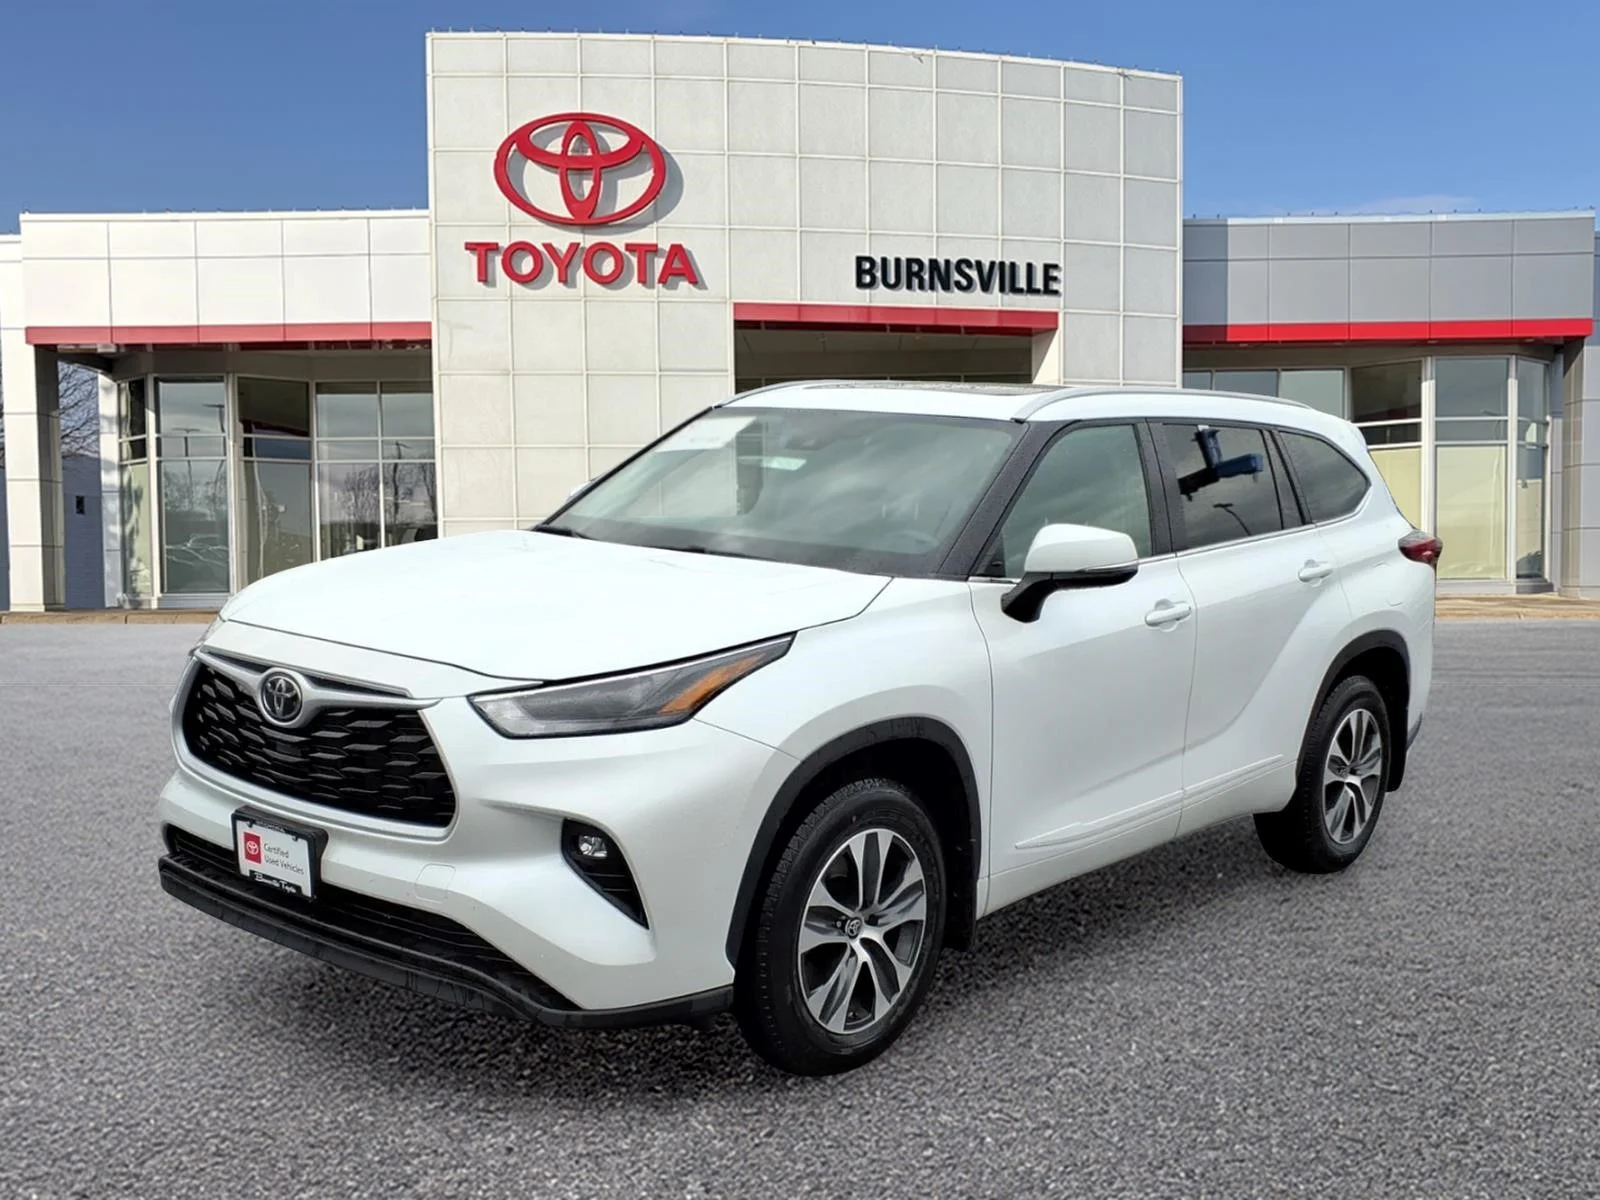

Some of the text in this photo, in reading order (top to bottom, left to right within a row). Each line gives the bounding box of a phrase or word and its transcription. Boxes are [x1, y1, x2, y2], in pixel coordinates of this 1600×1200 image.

[464, 241, 698, 284] TOYOTA
[855, 255, 1061, 295] BURNSVILLE
[264, 843, 289, 858] Certified
[280, 859, 304, 875] Vehicles
